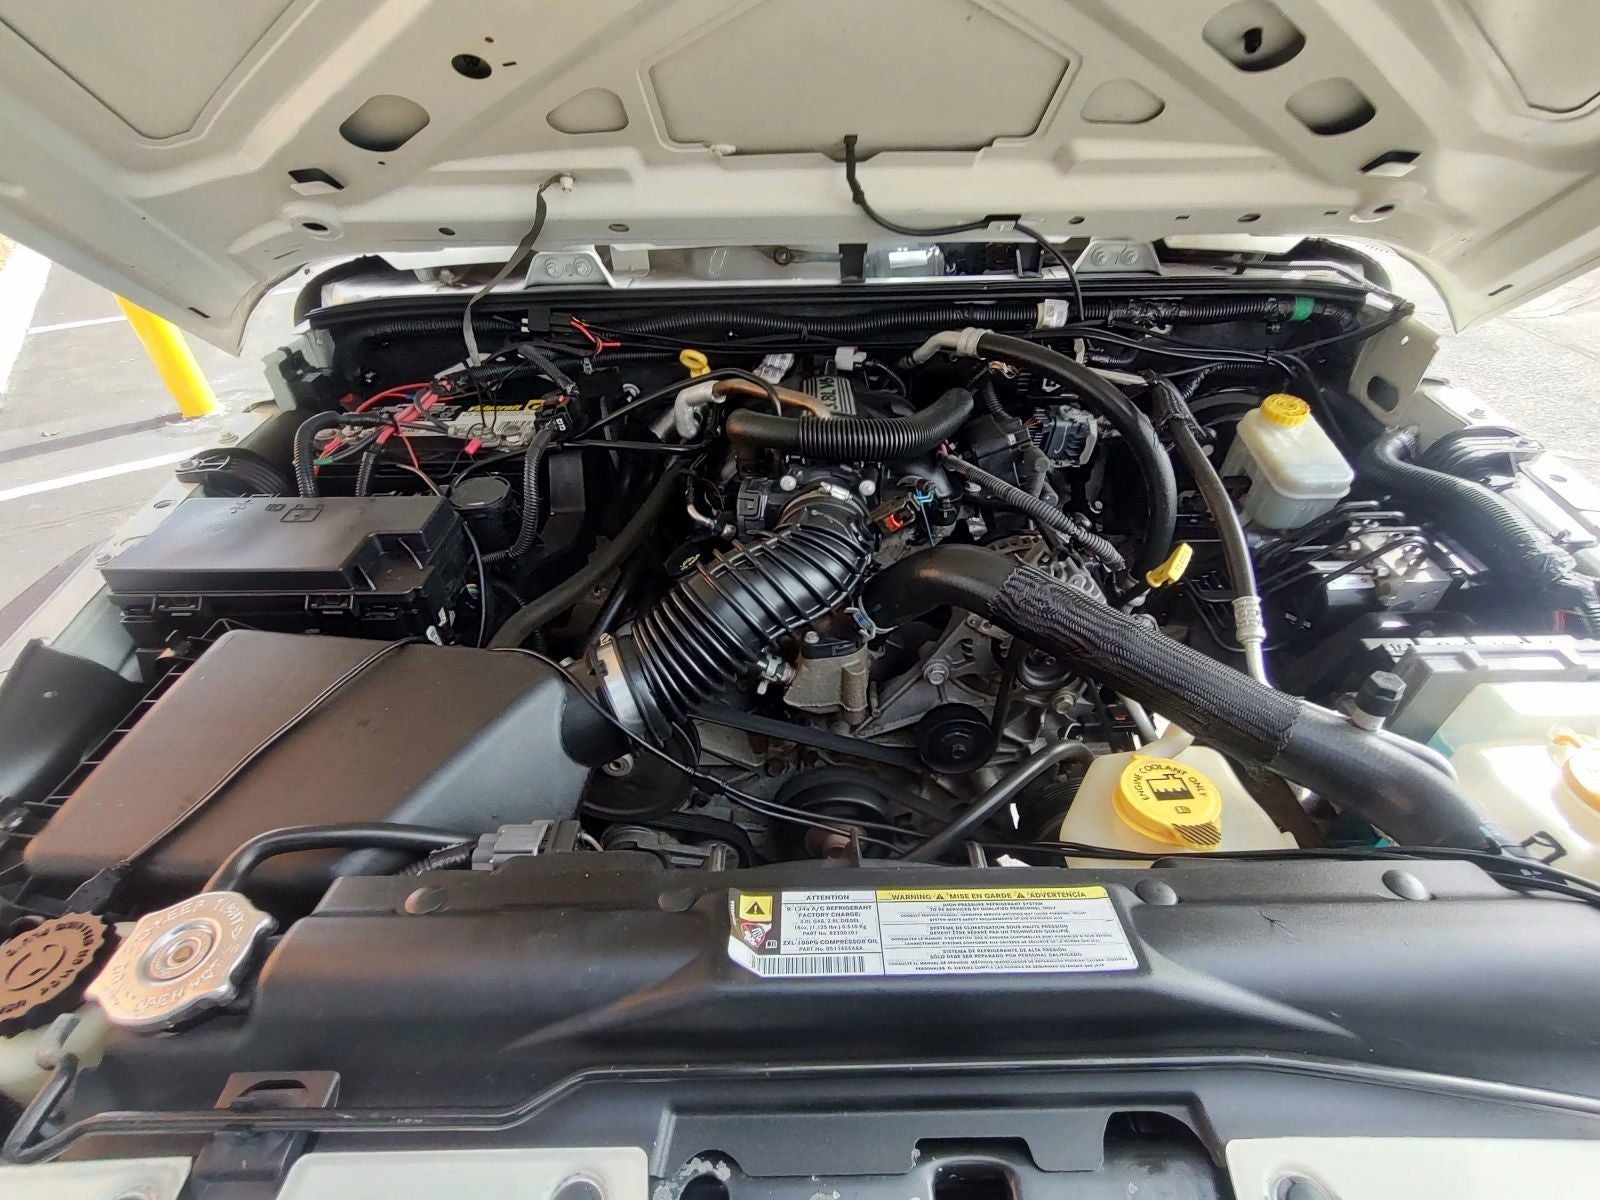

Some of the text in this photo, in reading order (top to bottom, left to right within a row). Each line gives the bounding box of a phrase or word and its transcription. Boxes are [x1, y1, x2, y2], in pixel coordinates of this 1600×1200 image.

[1132, 763, 1207, 801] ENGINE COOLANT ONLY
